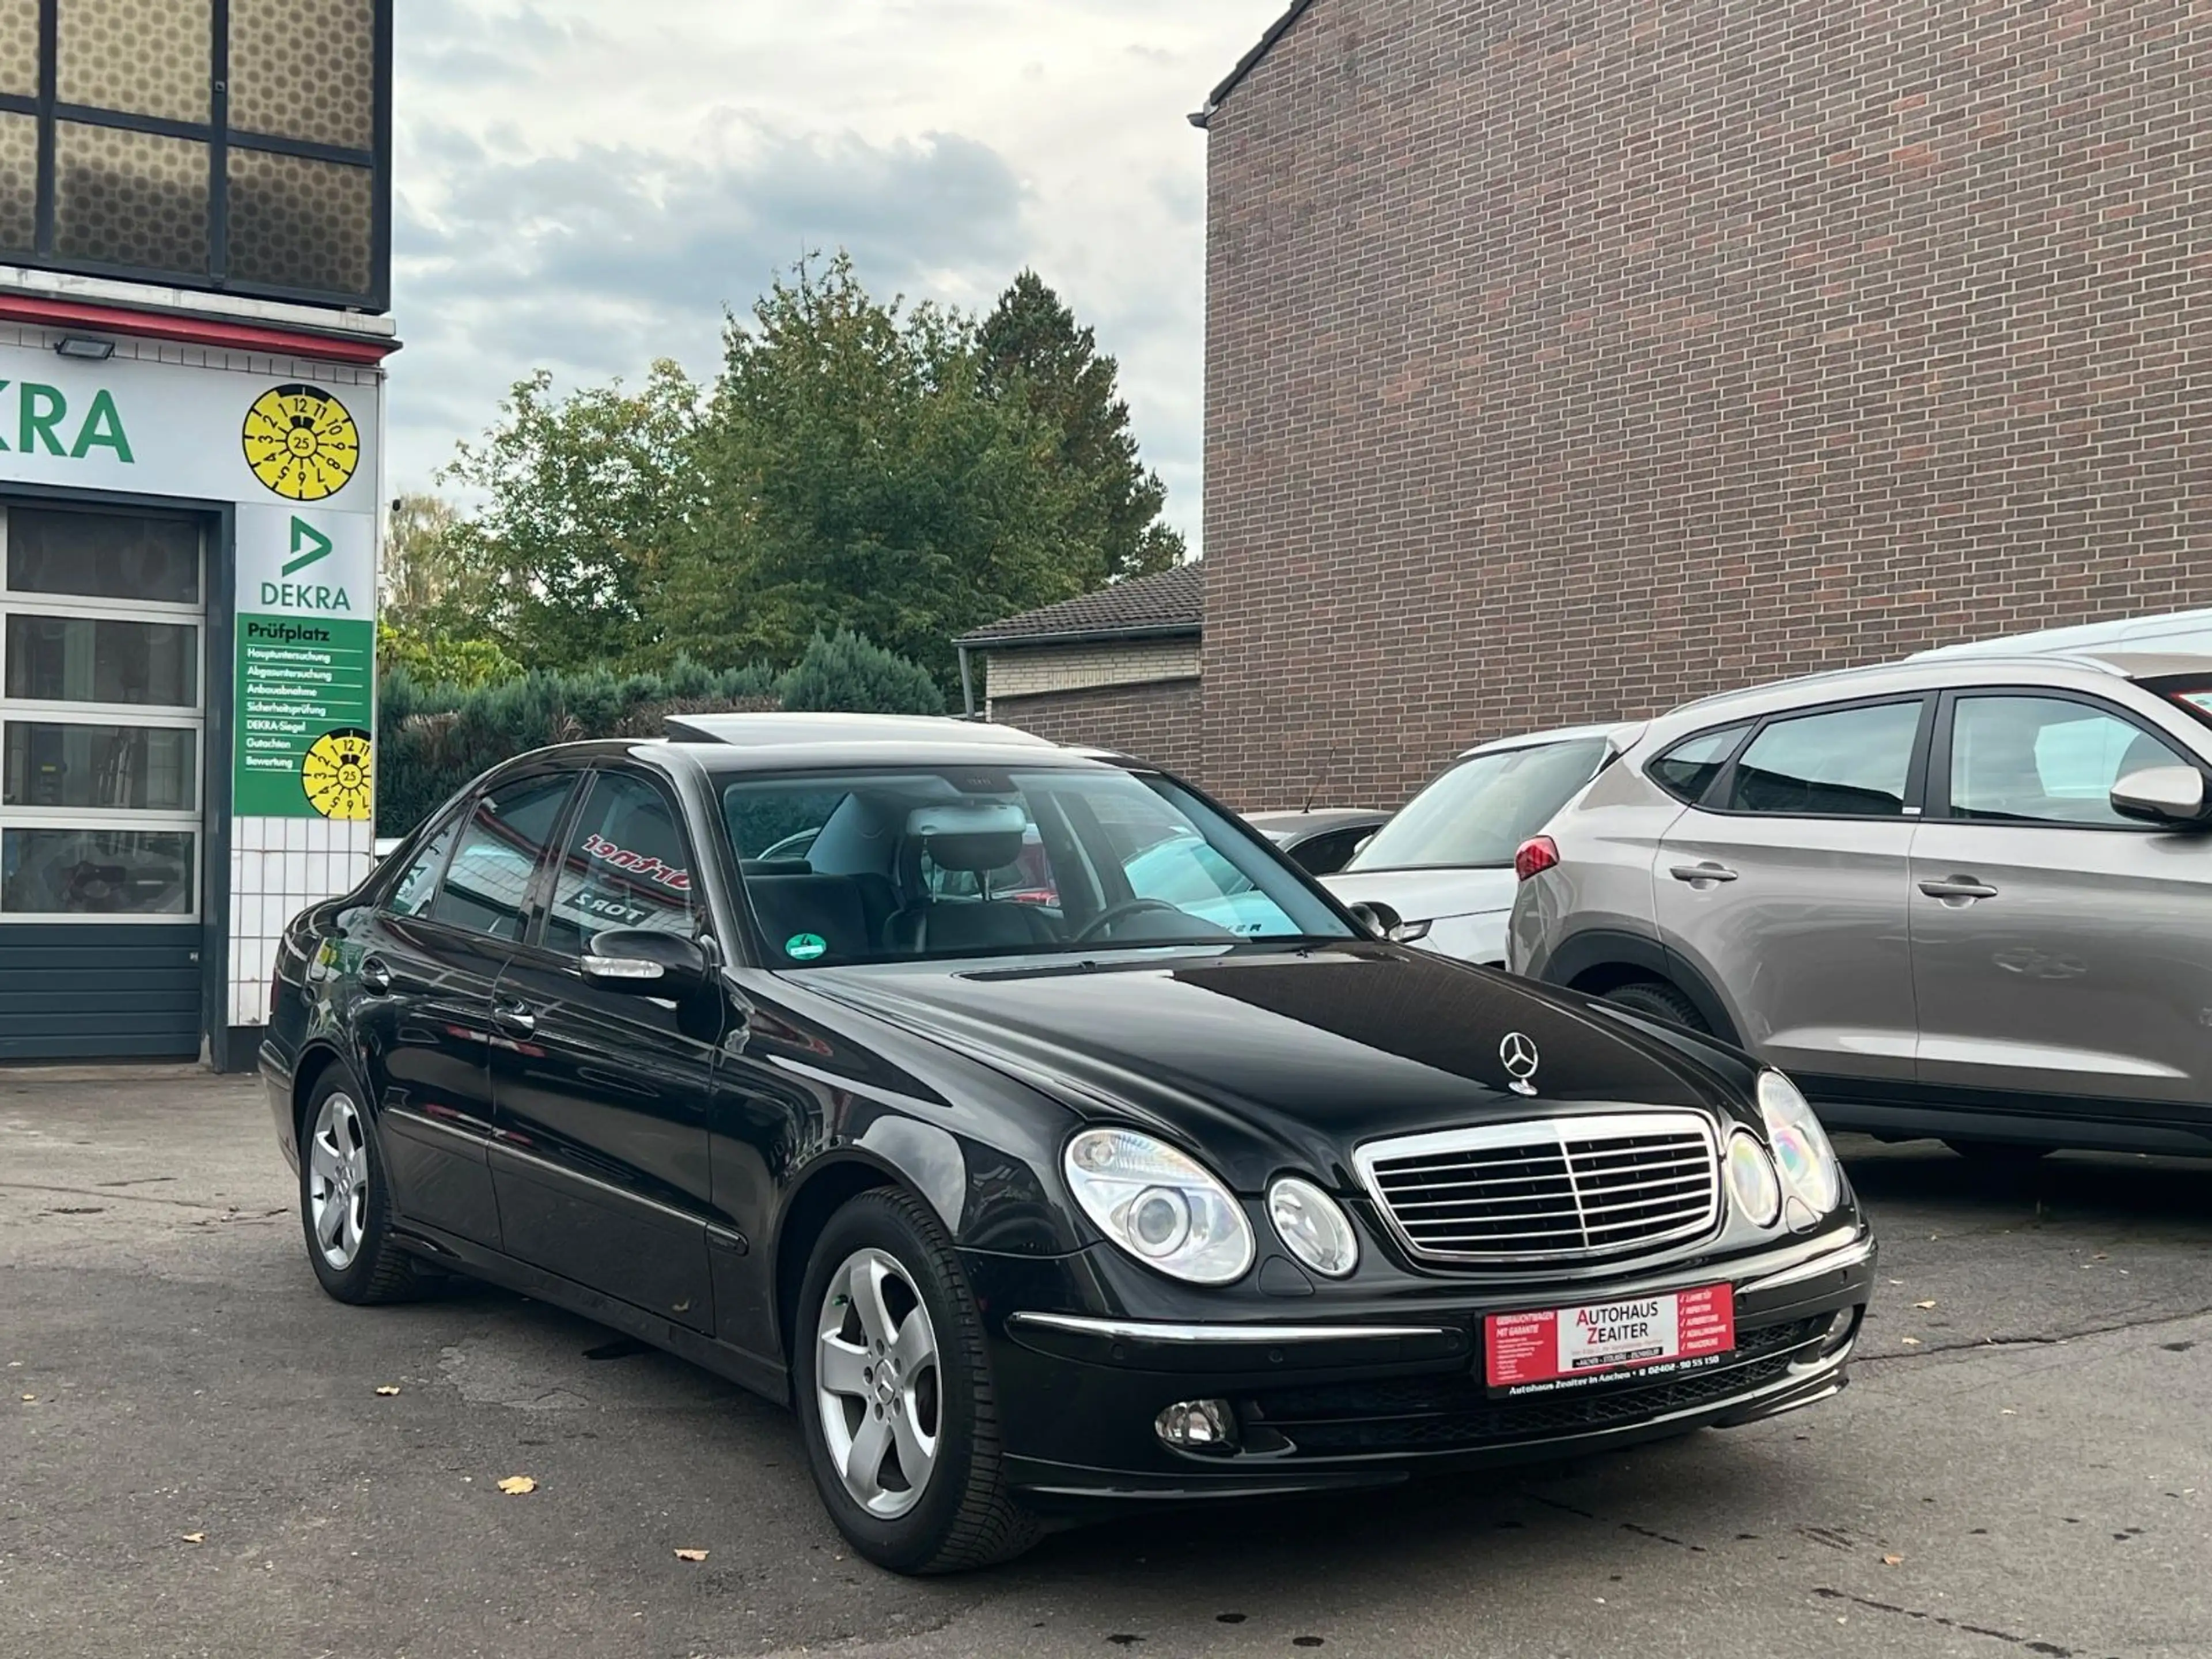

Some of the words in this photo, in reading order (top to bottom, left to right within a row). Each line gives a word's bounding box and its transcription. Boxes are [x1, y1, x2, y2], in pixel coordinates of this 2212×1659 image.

[294, 398, 308, 412] 12
[314, 403, 327, 420] 11
[0, 380, 135, 463] RA
[263, 415, 278, 429] 2
[326, 419, 343, 435] 10
[258, 435, 274, 444] 3
[293, 437, 309, 449] 25
[263, 453, 276, 461] 4
[326, 458, 340, 469] 8
[278, 466, 290, 480] 5
[317, 468, 325, 483] 7
[261, 582, 351, 611] DEKRA
[247, 622, 331, 643] Prüfplatz
[247, 647, 331, 665] Hauptuntersuchung
[247, 665, 332, 683] Abgasuntersuchung
[246, 701, 327, 717] Sicherheitsprüfung
[246, 719, 306, 734] DEKRA-Siegel
[246, 737, 291, 749] Gutachten
[343, 740, 354, 751] 12
[246, 755, 293, 770] Bewertung
[317, 756, 331, 766] 2
[343, 771, 356, 782] 25
[329, 796, 340, 808] 5
[1509, 1382, 1554, 1396] Autohaus
[1555, 1377, 1588, 1389] Zeaiter
[1589, 1376, 1598, 1384] in
[1599, 1370, 1631, 1382] Aachen
